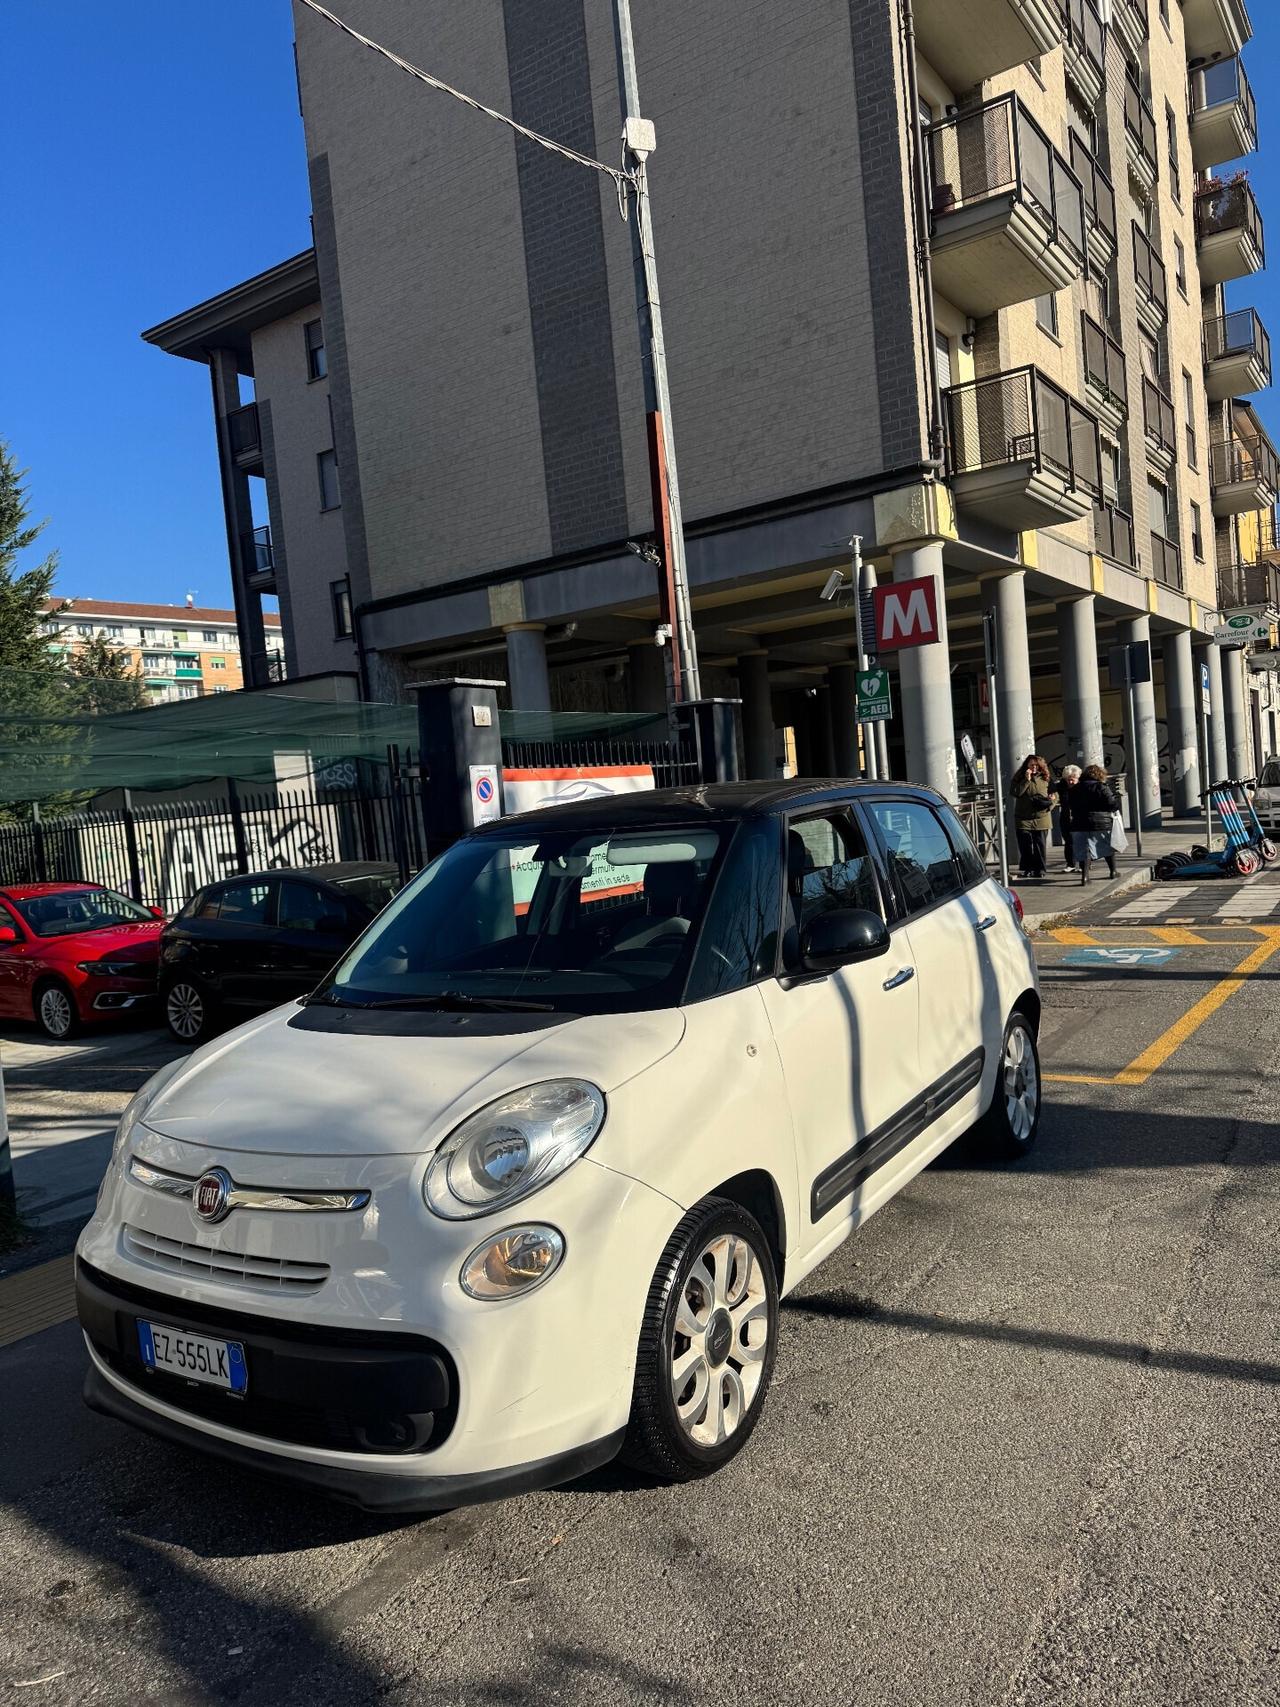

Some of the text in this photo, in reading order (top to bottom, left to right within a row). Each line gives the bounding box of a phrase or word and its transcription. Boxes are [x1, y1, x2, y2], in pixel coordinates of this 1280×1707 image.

[882, 588, 933, 640] M
[1215, 629, 1248, 639] Carrefour
[1202, 667, 1208, 686] P
[870, 703, 888, 715] AED
[613, 873, 631, 884] sede
[200, 1186, 218, 1206] FIAT
